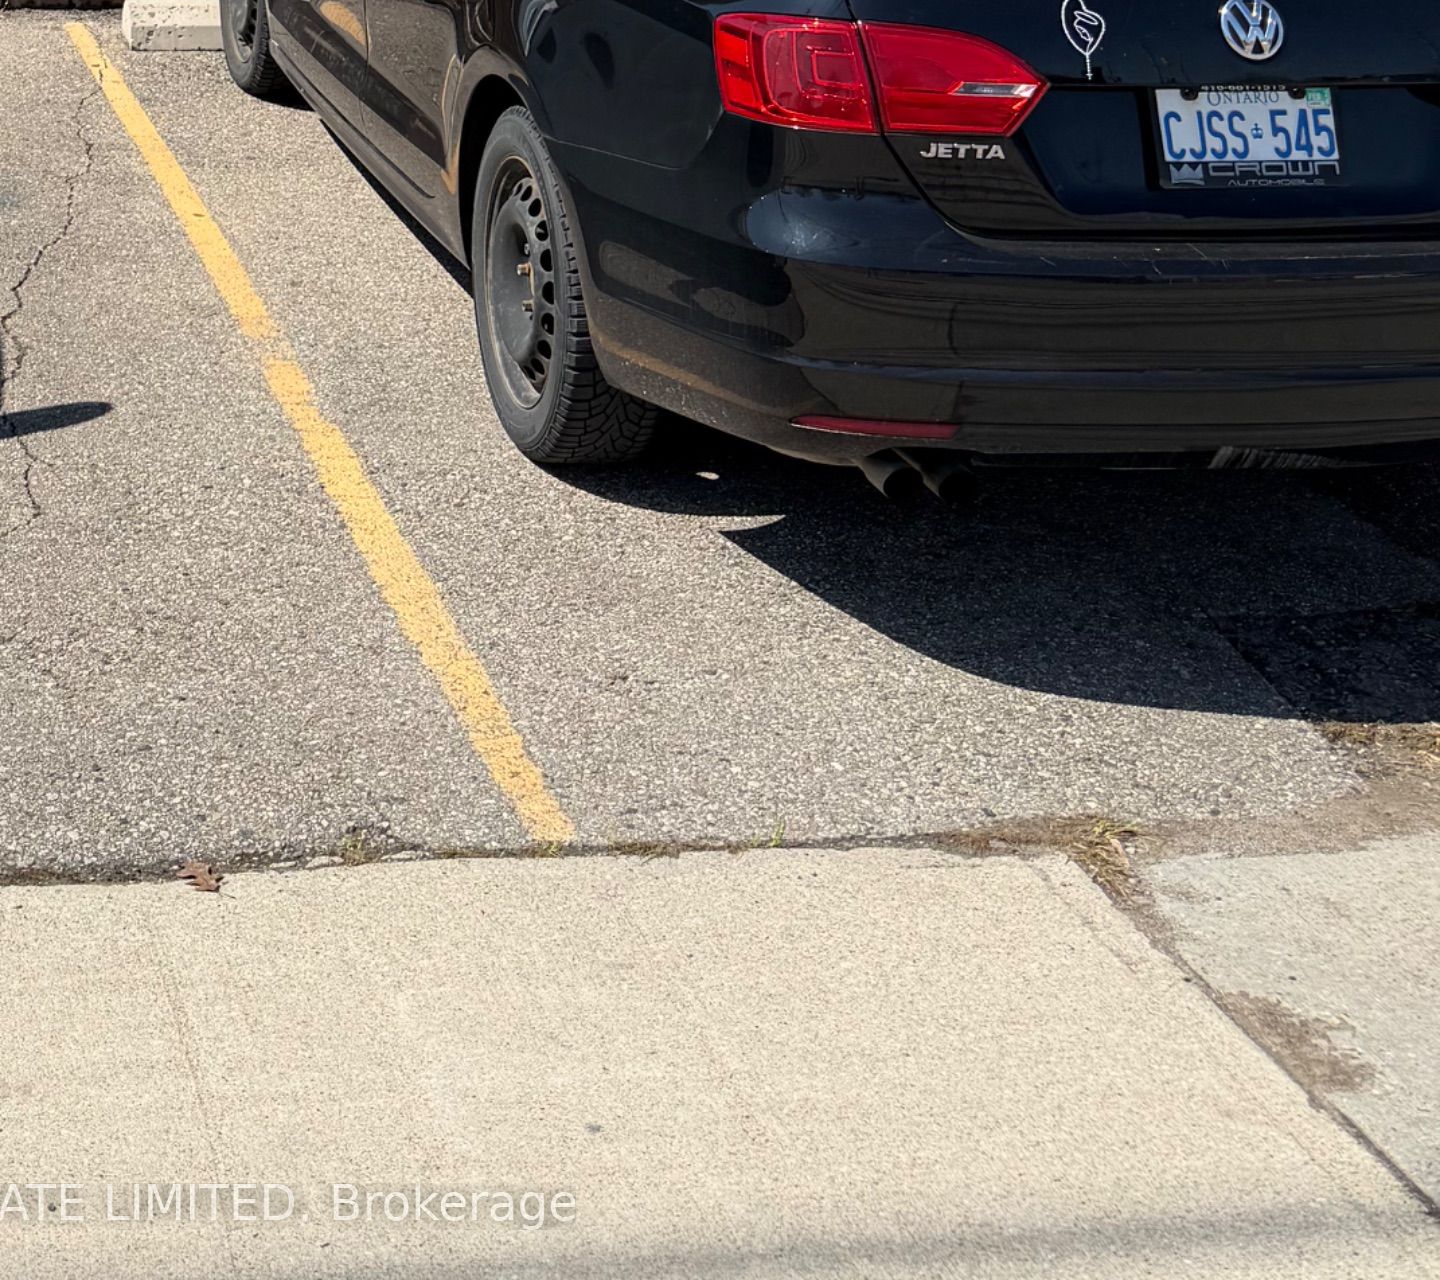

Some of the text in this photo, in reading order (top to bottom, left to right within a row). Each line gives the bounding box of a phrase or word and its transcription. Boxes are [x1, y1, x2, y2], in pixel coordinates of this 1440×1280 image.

[1163, 108, 1336, 160] CJSS 545
[920, 142, 1006, 160] JETTA
[1208, 160, 1340, 176] CROWN
